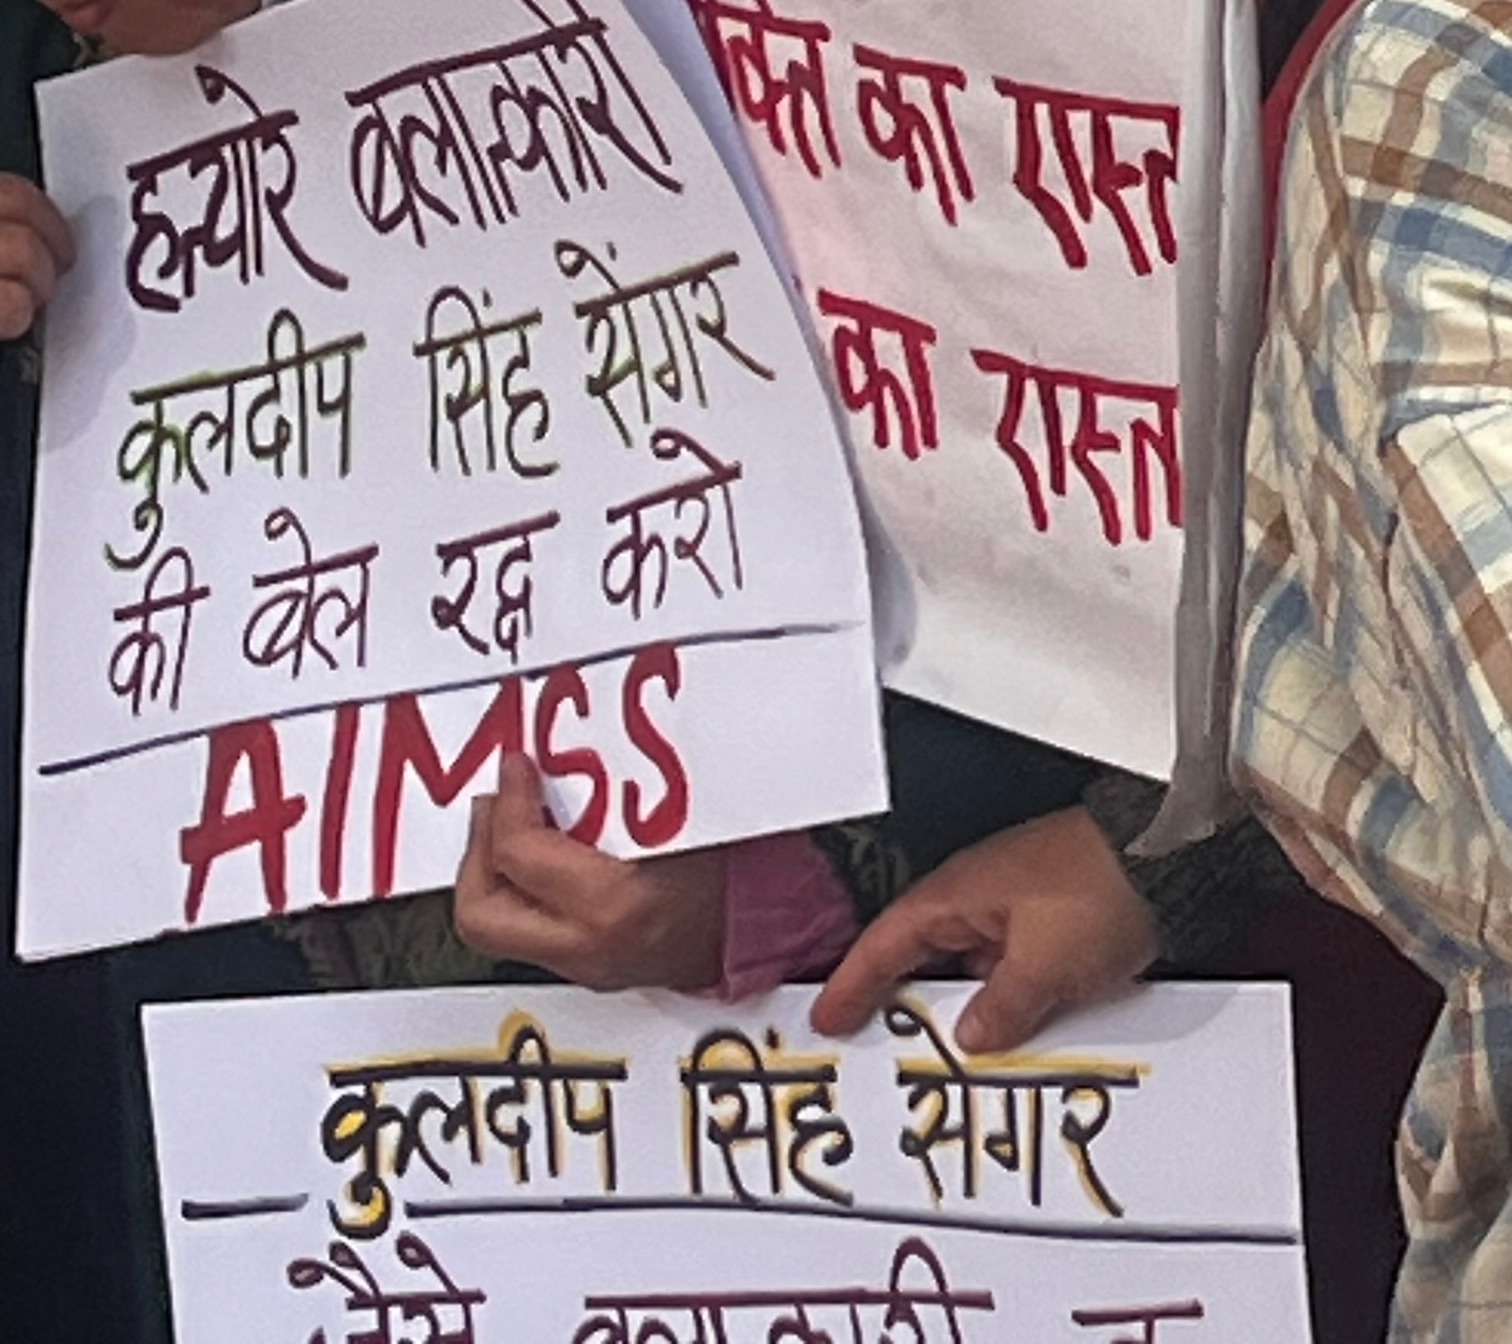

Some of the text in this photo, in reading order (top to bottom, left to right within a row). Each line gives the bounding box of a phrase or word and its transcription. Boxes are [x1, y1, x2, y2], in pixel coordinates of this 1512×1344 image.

[853, 43, 975, 226] का
[993, 75, 1181, 276] रास्त
[103, 240, 777, 569] कुलदीप सिंह सेंगर
[818, 288, 1184, 547] का रास्त
[108, 548, 209, 716] की
[601, 427, 744, 621] करो
[180, 641, 692, 923] AIMSS
[320, 1008, 630, 1237] कुलदीप
[678, 1027, 855, 1205] सिंह
